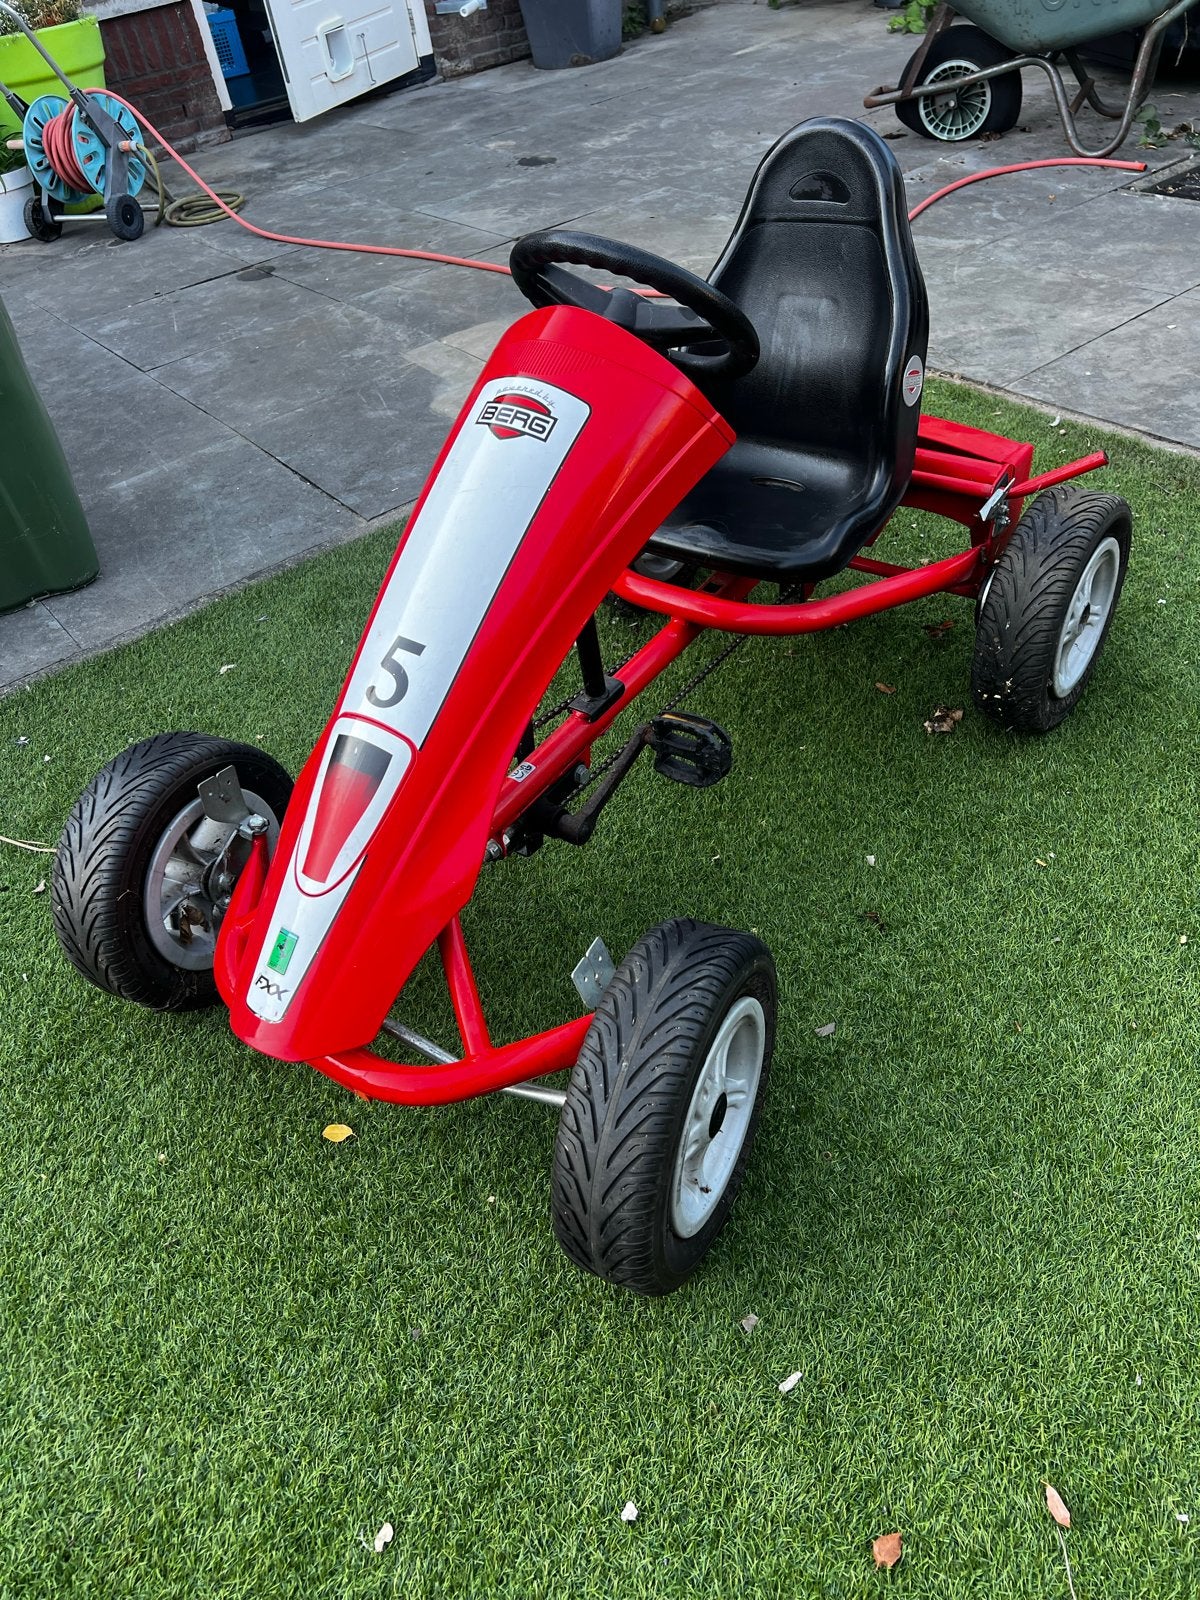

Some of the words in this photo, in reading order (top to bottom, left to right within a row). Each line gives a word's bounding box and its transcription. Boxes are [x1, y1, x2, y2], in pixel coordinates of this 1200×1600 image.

[481, 406, 549, 434] BERG
[366, 635, 427, 708] 5
[255, 975, 290, 1001] FXX
